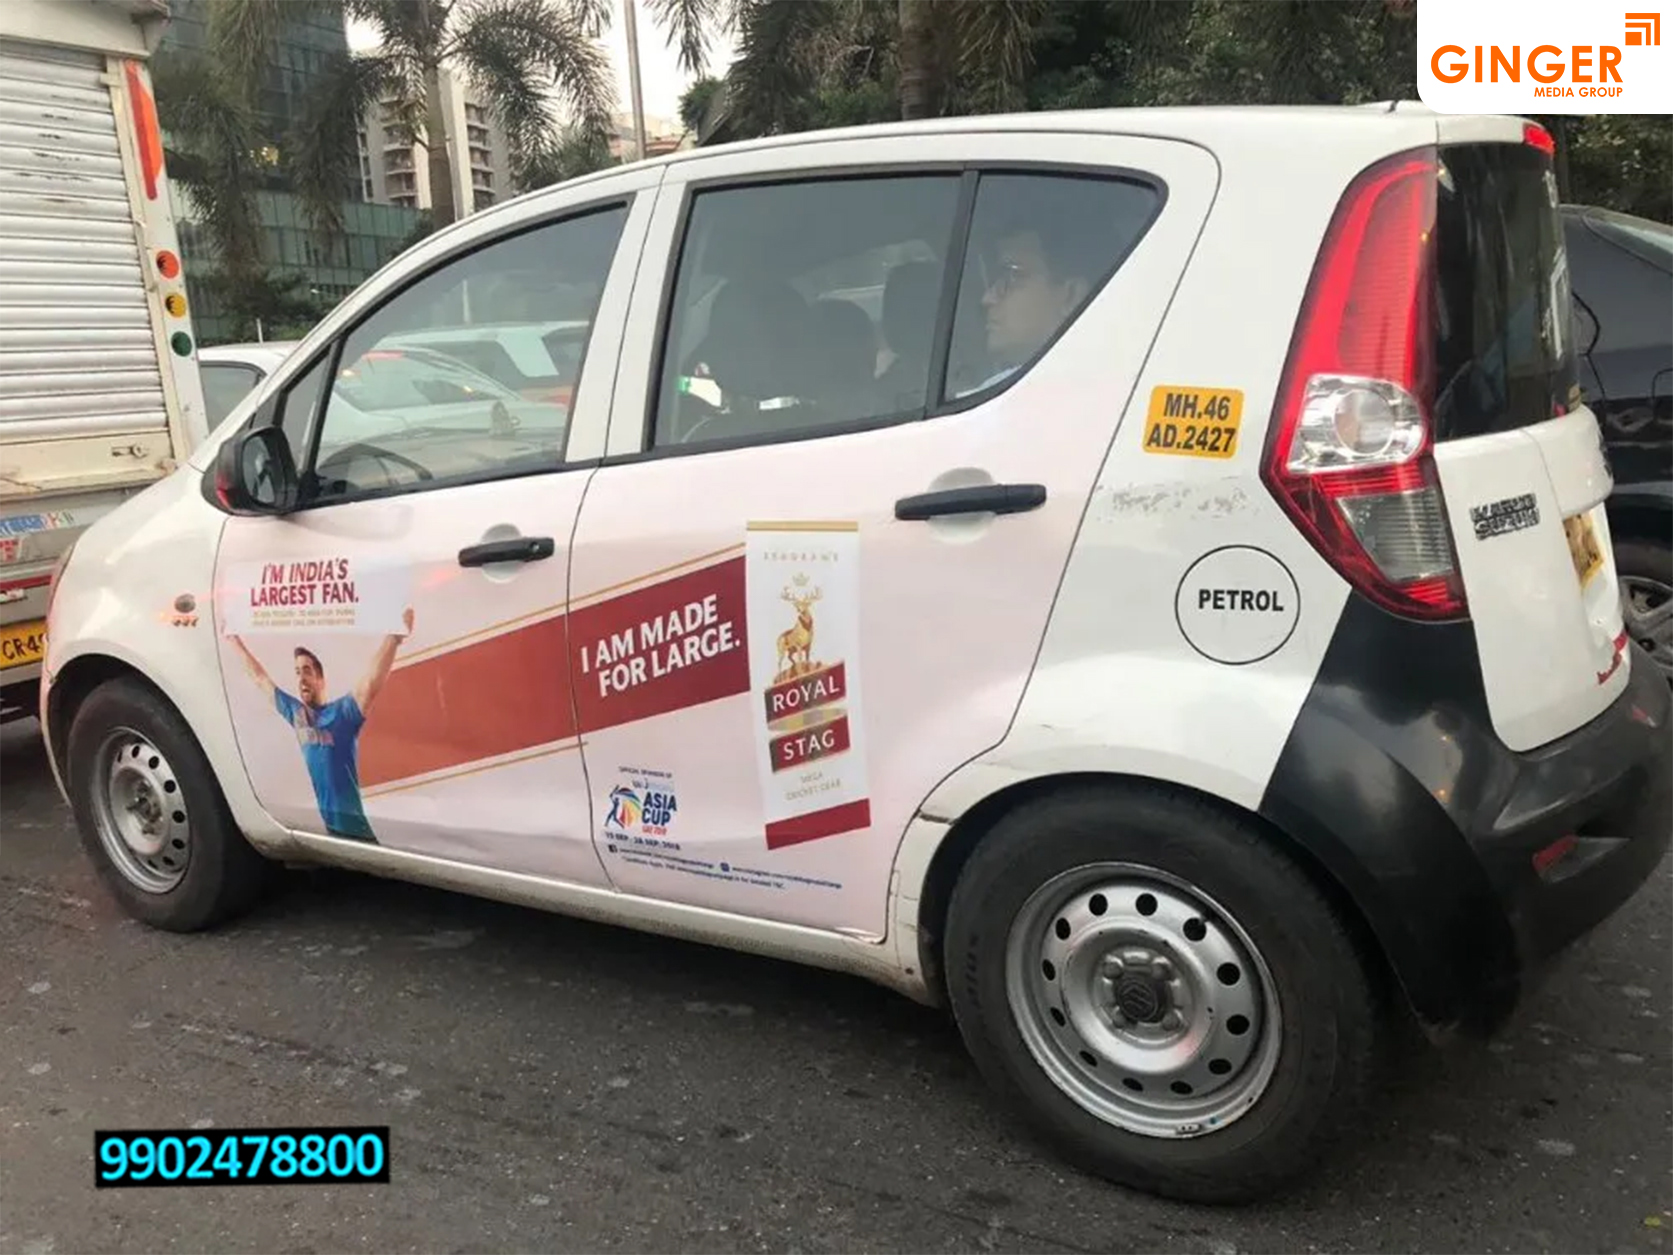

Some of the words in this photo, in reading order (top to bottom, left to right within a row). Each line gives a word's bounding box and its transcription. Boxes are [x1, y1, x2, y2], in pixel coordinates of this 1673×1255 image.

[1164, 393, 1231, 421] MH.46
[1147, 423, 1236, 452] AD.2427
[262, 562, 285, 584] I'M
[289, 558, 349, 583] INDIA'S
[251, 584, 317, 607] LARGEST
[322, 582, 359, 604] FAN.
[1198, 589, 1284, 612] PETROL
[581, 646, 589, 674] I
[595, 628, 635, 668] AM
[640, 593, 718, 650] MADE
[599, 656, 647, 698] FOR
[651, 621, 741, 678] LARGE.
[773, 675, 840, 712] ROYAL
[783, 729, 834, 760] STAG
[643, 791, 677, 812] ASIA
[641, 808, 671, 826] CUP
